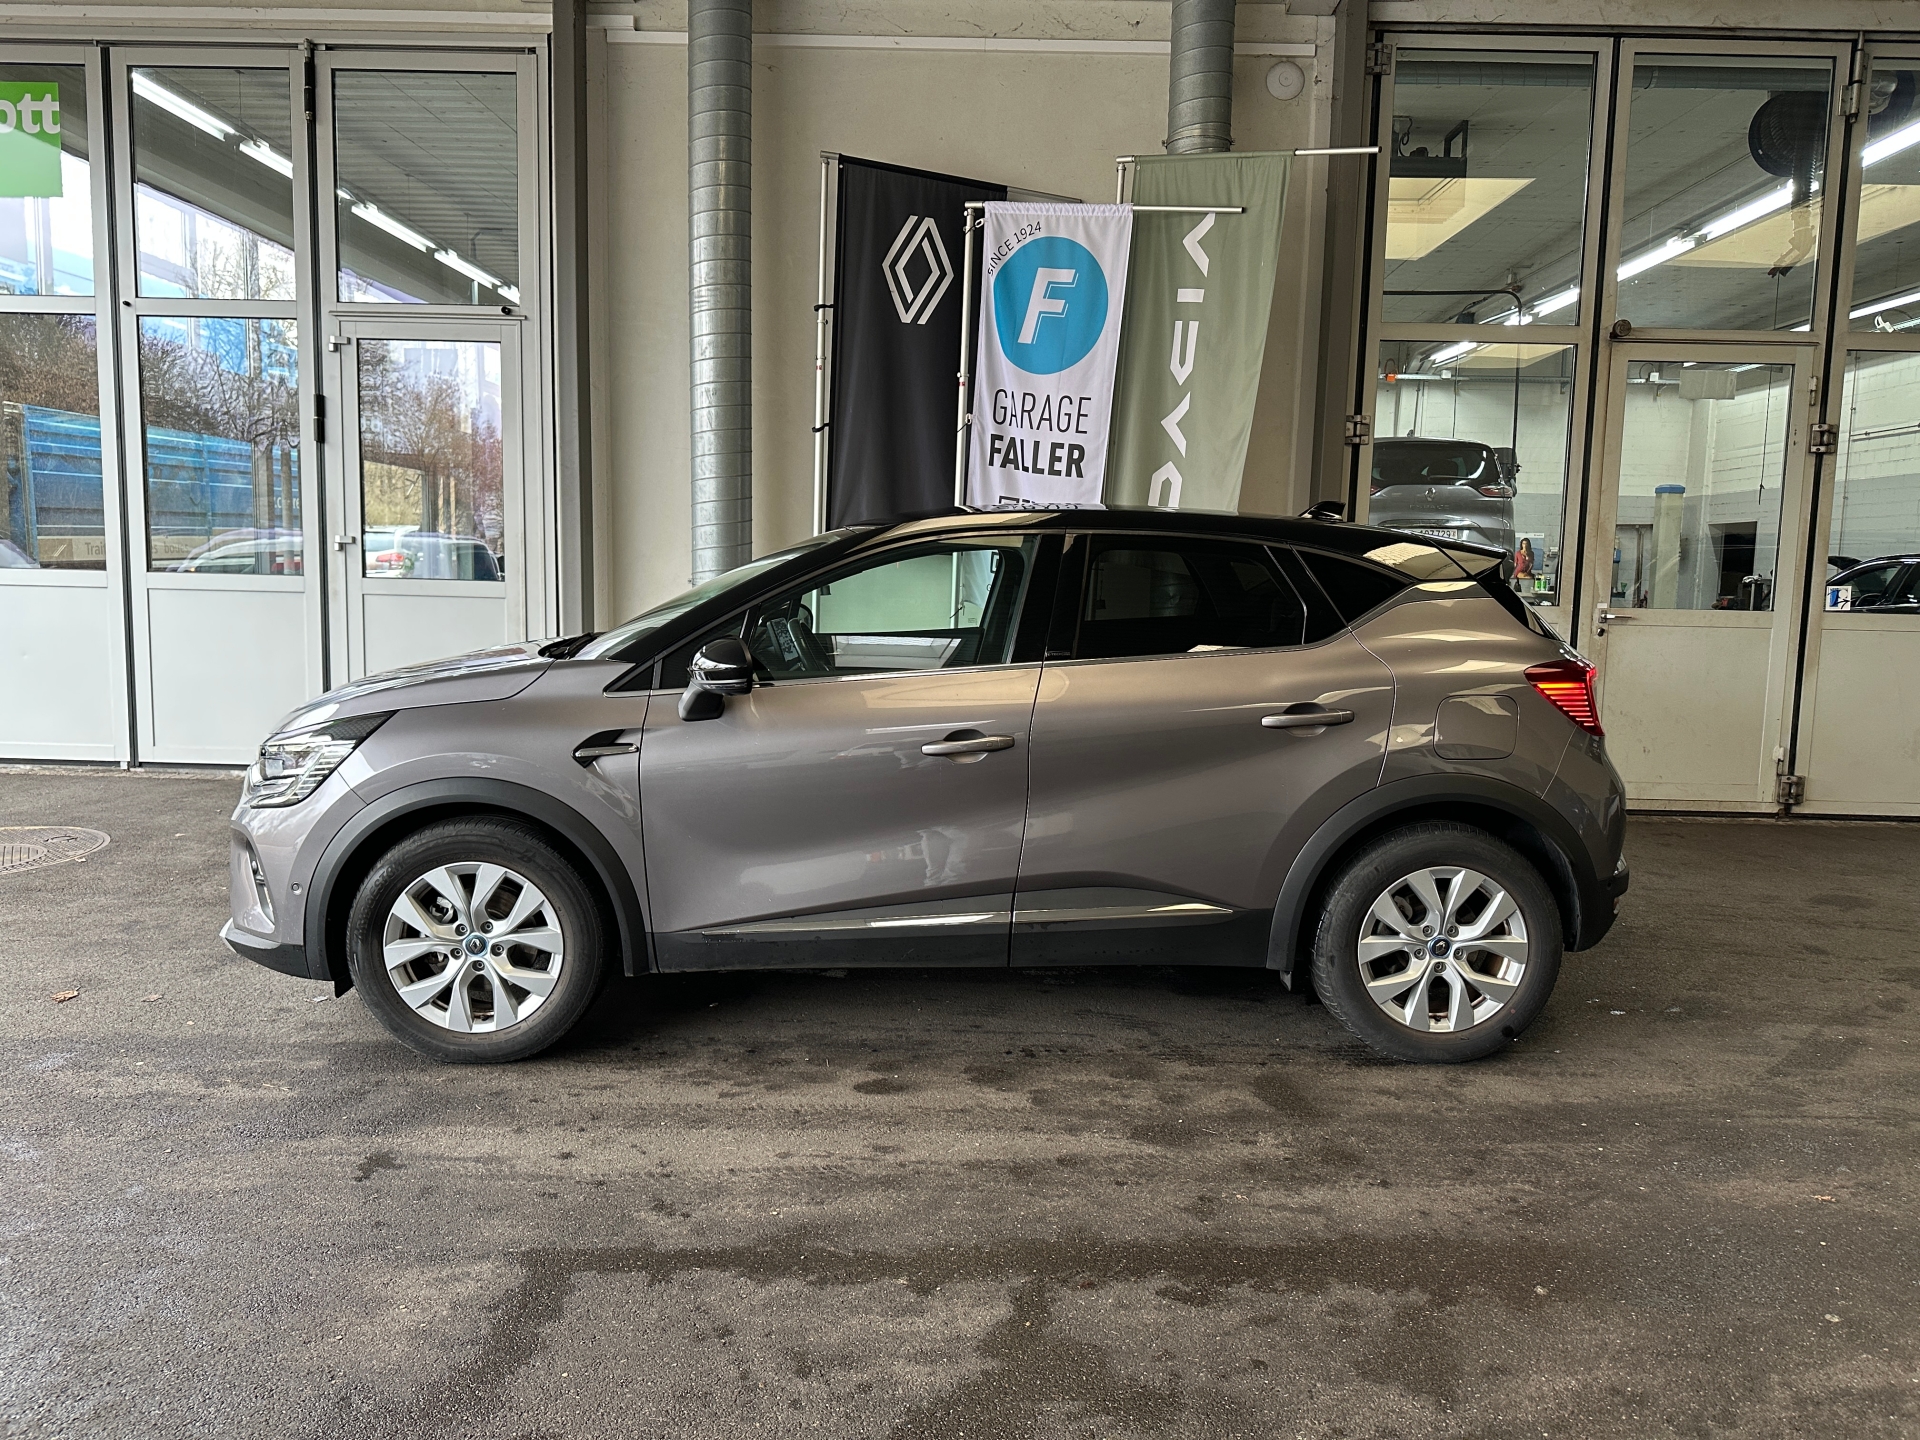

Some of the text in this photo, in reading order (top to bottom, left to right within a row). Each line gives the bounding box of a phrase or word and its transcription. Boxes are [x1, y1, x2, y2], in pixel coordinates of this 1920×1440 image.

[987, 221, 1042, 276] SINCE 1924
[1017, 267, 1079, 345] F
[992, 388, 1092, 434] GARAGE
[988, 433, 1086, 479] FALLER
[85, 541, 106, 555] Trai
